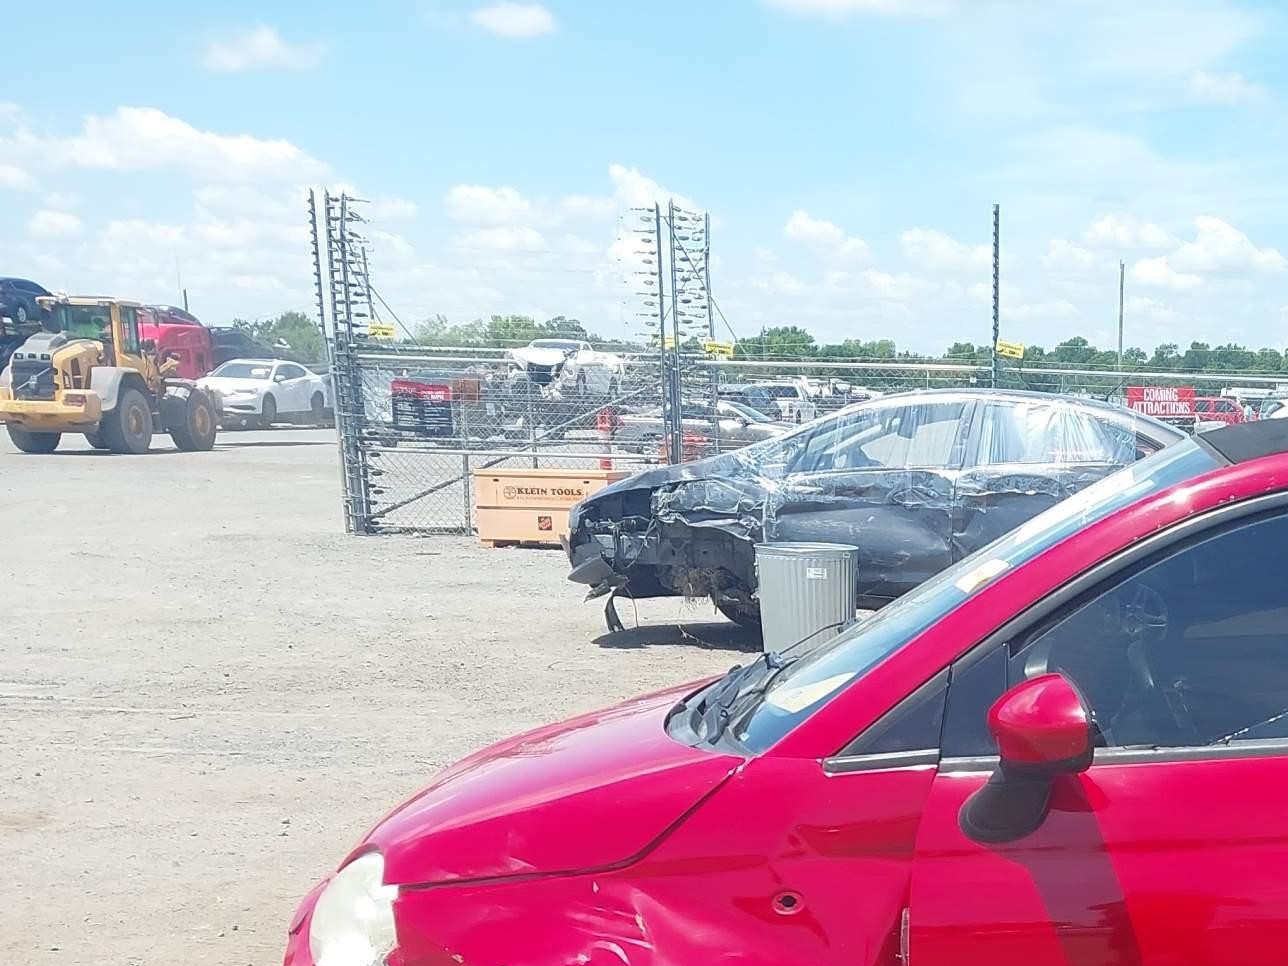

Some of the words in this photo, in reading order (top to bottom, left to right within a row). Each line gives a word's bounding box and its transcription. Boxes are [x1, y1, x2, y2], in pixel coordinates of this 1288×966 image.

[1143, 388, 1178, 402] COMING
[1133, 401, 1191, 414] ATTRACTIONS
[516, 487, 548, 495] KLEIN
[550, 488, 582, 496] TOOLS
